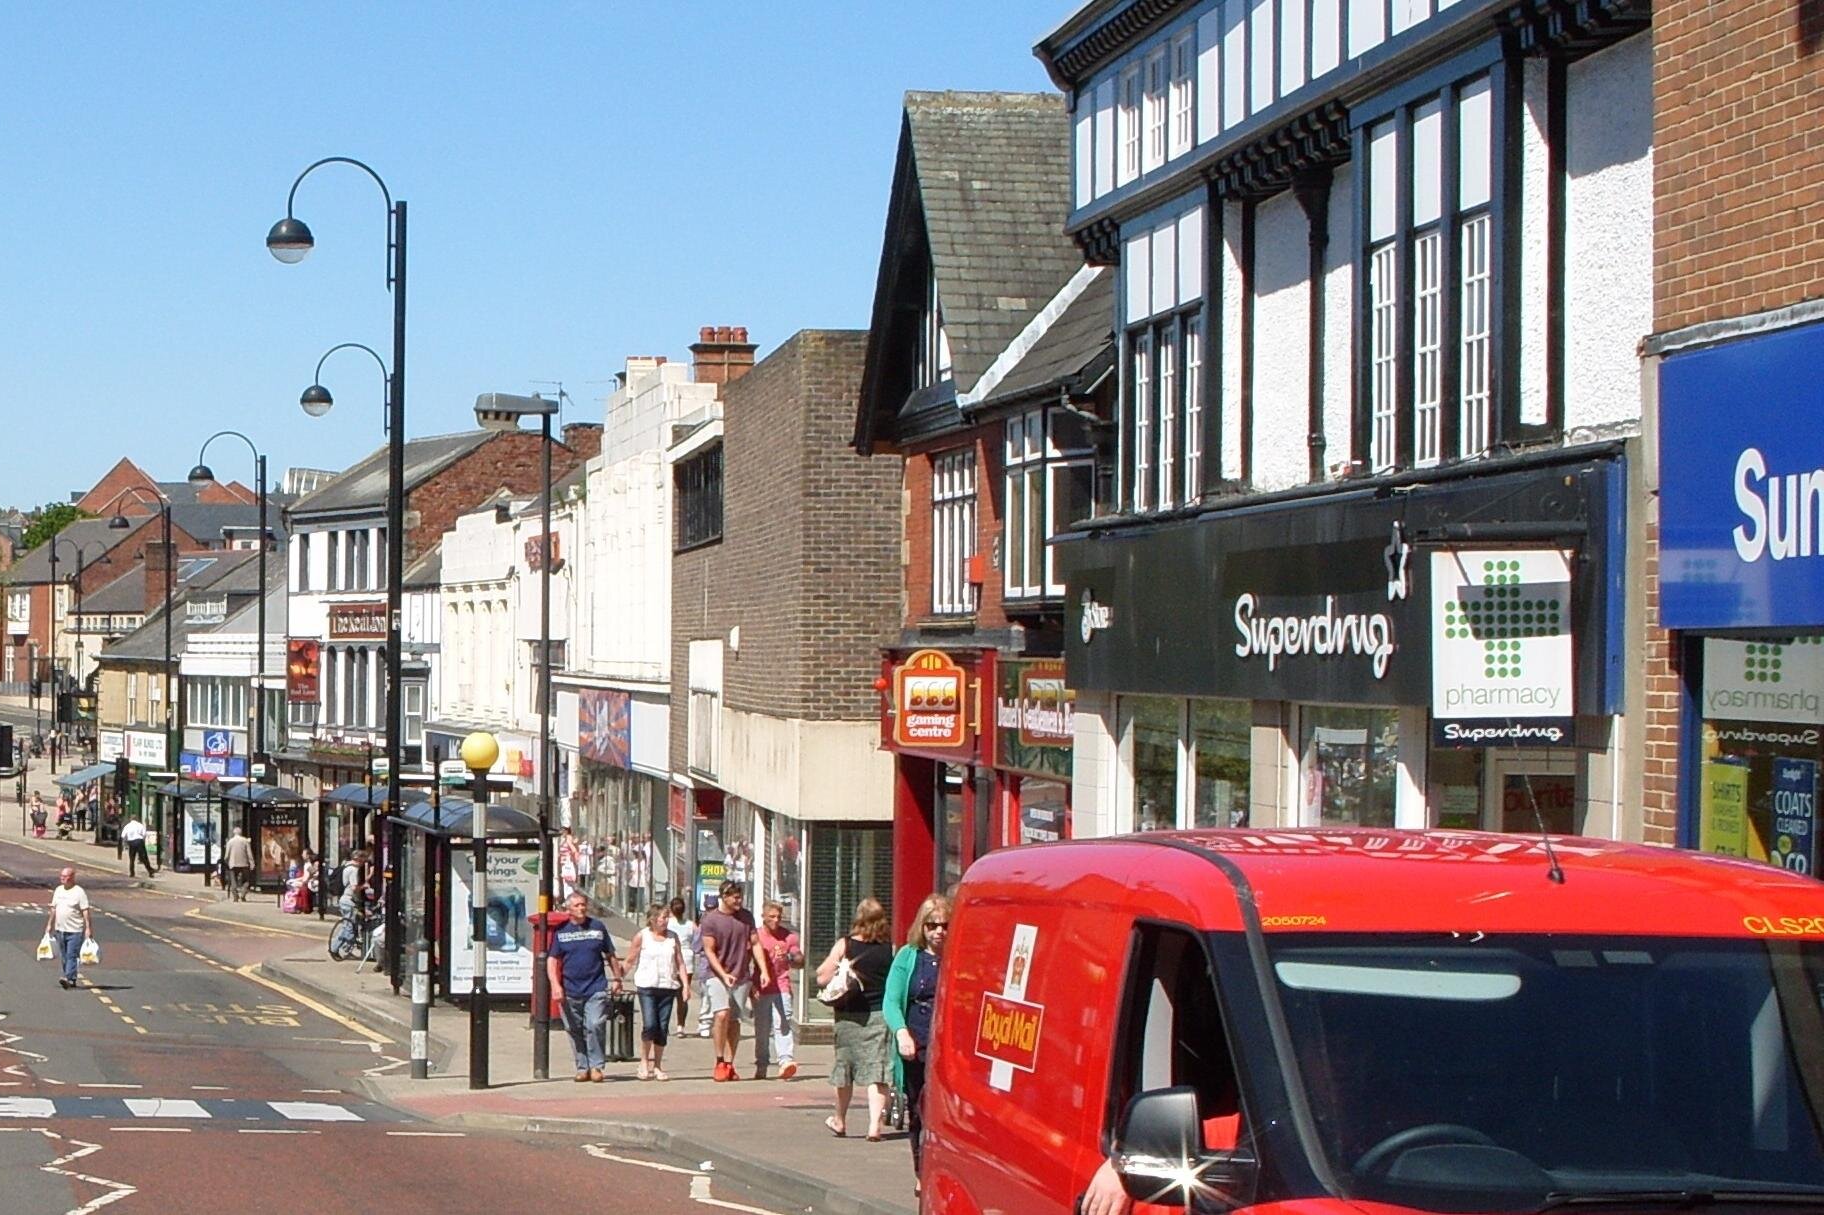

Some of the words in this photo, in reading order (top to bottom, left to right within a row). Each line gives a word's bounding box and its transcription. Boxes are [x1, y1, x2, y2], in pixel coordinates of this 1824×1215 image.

[1235, 592, 1394, 680] Superdrug
[1446, 681, 1561, 711] pharmacy
[906, 714, 955, 728] gaming
[909, 726, 952, 737] centre
[1443, 723, 1563, 742] Superdrug
[1775, 790, 1812, 818] COATS
[1777, 817, 1809, 836] CLEANED
[495, 856, 520, 867] your
[982, 1003, 1014, 1051] Royal
[1013, 1009, 1038, 1052] Mail
